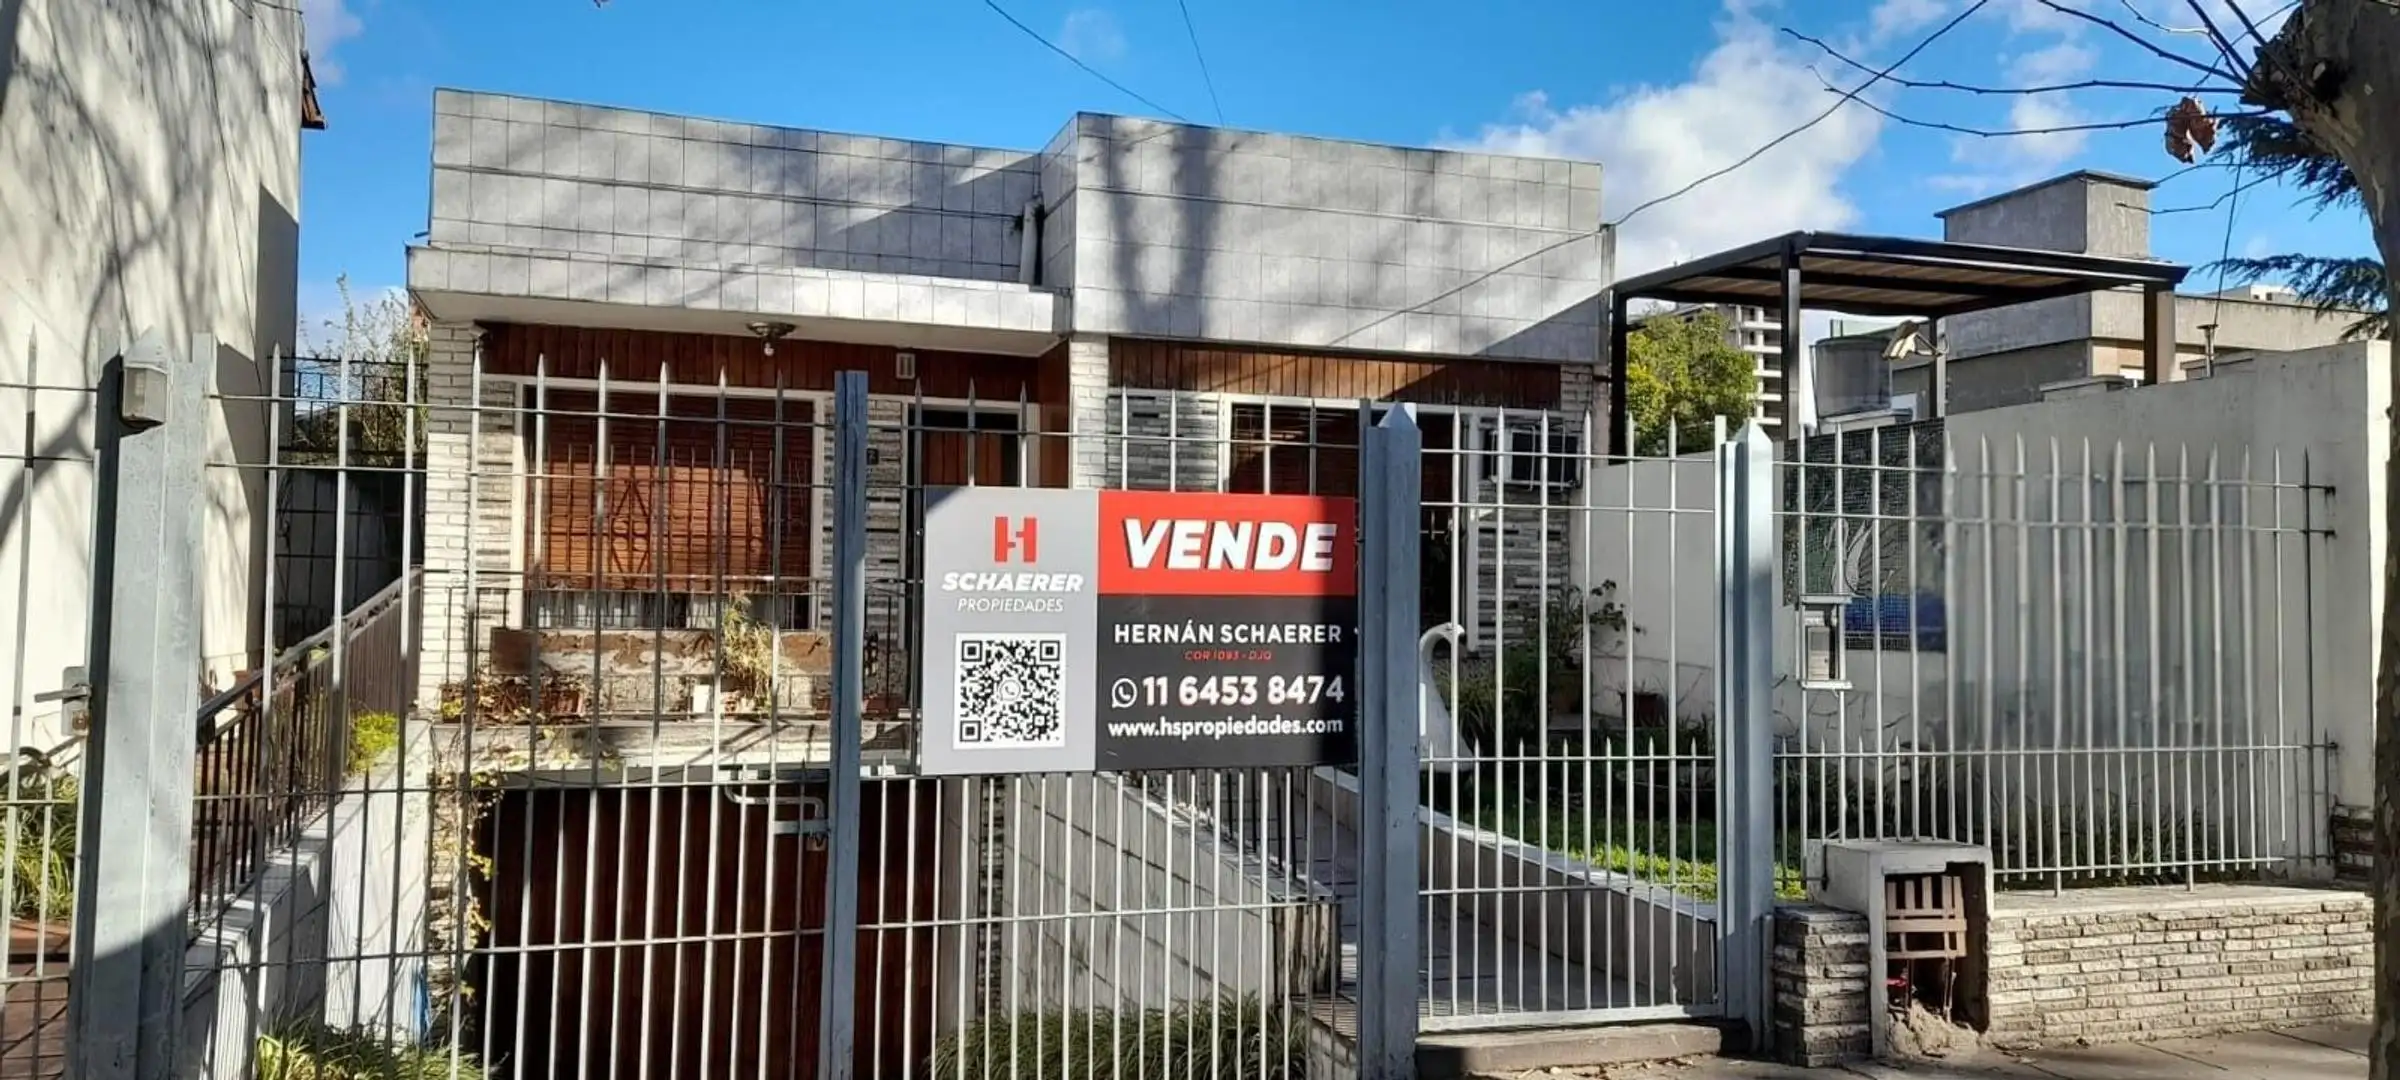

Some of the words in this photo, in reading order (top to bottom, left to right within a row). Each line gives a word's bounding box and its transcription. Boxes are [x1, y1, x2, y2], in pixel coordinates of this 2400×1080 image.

[1123, 518, 1337, 571] VENDE
[941, 572, 1084, 592] SCHAERER
[957, 598, 1064, 612] PROPIEDADES
[1114, 619, 1214, 644] HERNÁN
[1220, 624, 1341, 644] SCHAERER
[1142, 676, 1168, 706] 11
[1178, 675, 1258, 706] 6453
[1267, 675, 1345, 705] 8474
[1109, 714, 1344, 740] www.hspropiedades.com
